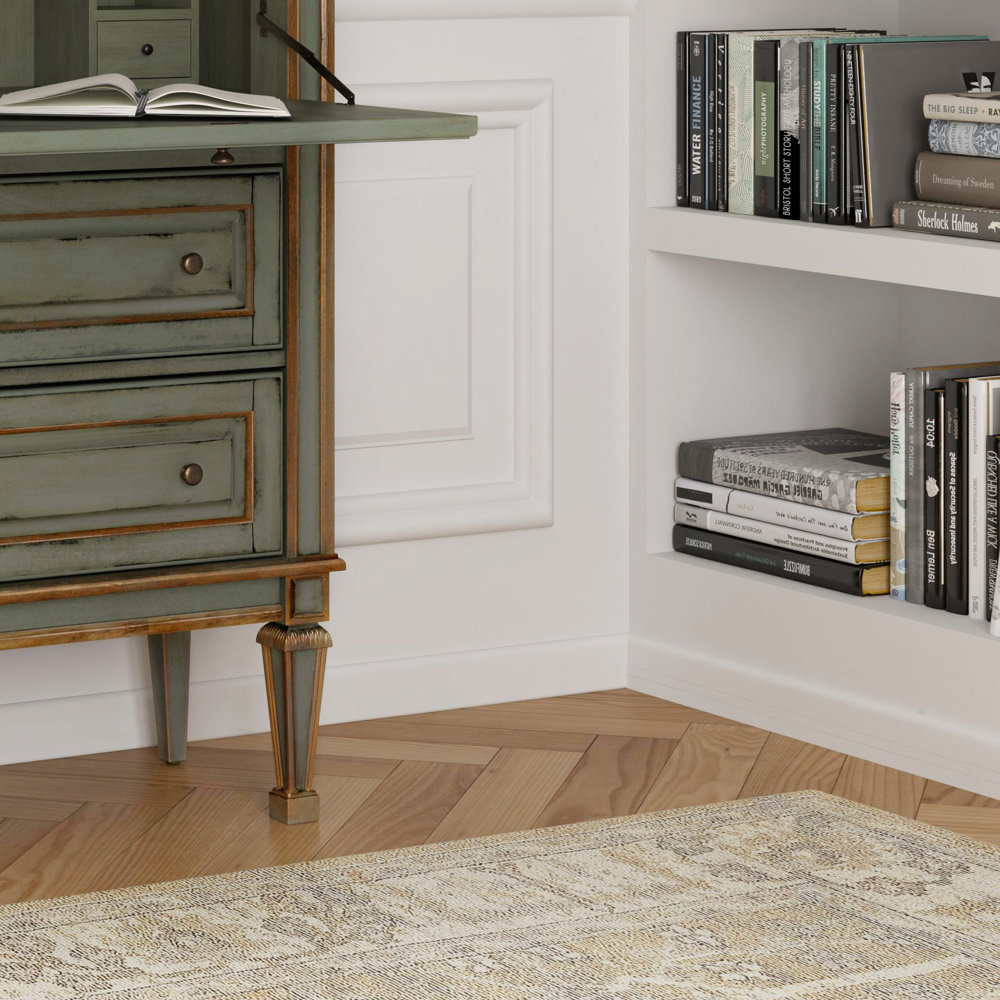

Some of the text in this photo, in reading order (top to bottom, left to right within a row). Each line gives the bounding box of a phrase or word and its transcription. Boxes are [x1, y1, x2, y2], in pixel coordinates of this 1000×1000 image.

[927, 104, 979, 114] THE BIG SLEEP
[692, 75, 701, 175] WATER FINANCE
[782, 158, 792, 184] SHORT
[932, 173, 962, 189] Dreaming
[963, 176, 970, 187] of
[970, 177, 995, 189] Sweden
[782, 187, 792, 217] BRISTOL
[917, 209, 979, 234] Sherlock Holmes
